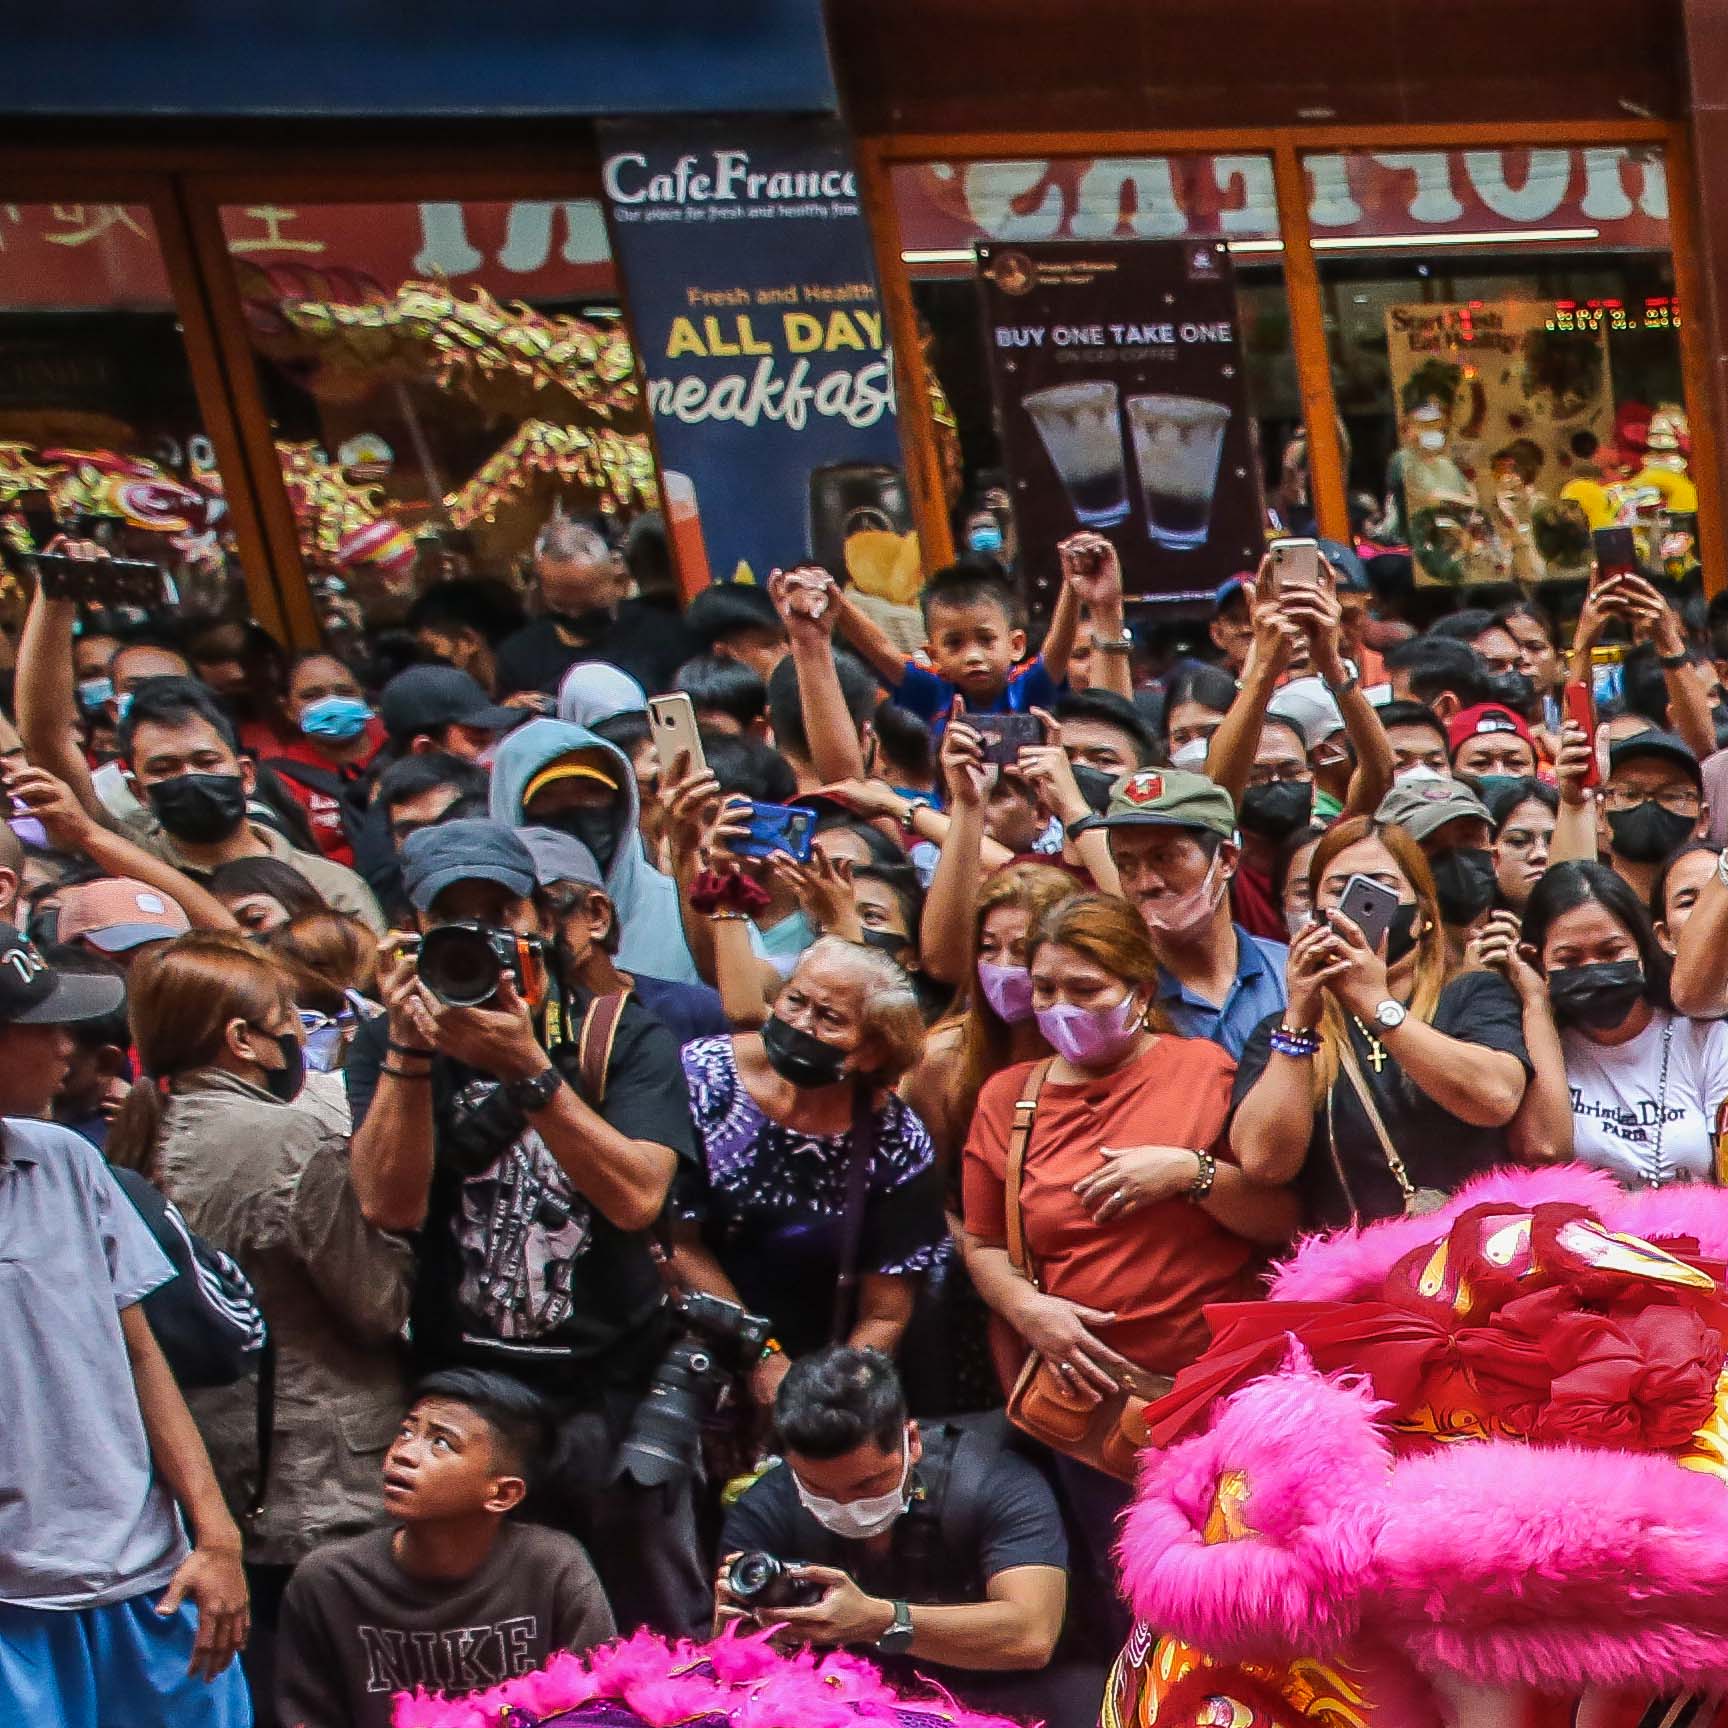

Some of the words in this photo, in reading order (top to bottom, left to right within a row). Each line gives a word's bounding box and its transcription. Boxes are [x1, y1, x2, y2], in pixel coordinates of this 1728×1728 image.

[687, 286, 750, 307] Fresh
[756, 285, 799, 305] and
[665, 315, 774, 359] ALL
[783, 309, 884, 353] DAY
[994, 325, 1045, 347] BUY
[1052, 323, 1105, 346] ONE
[1108, 322, 1177, 345] TAKE
[1180, 321, 1232, 343] ONE
[357, 1615, 538, 1693] NIKE
